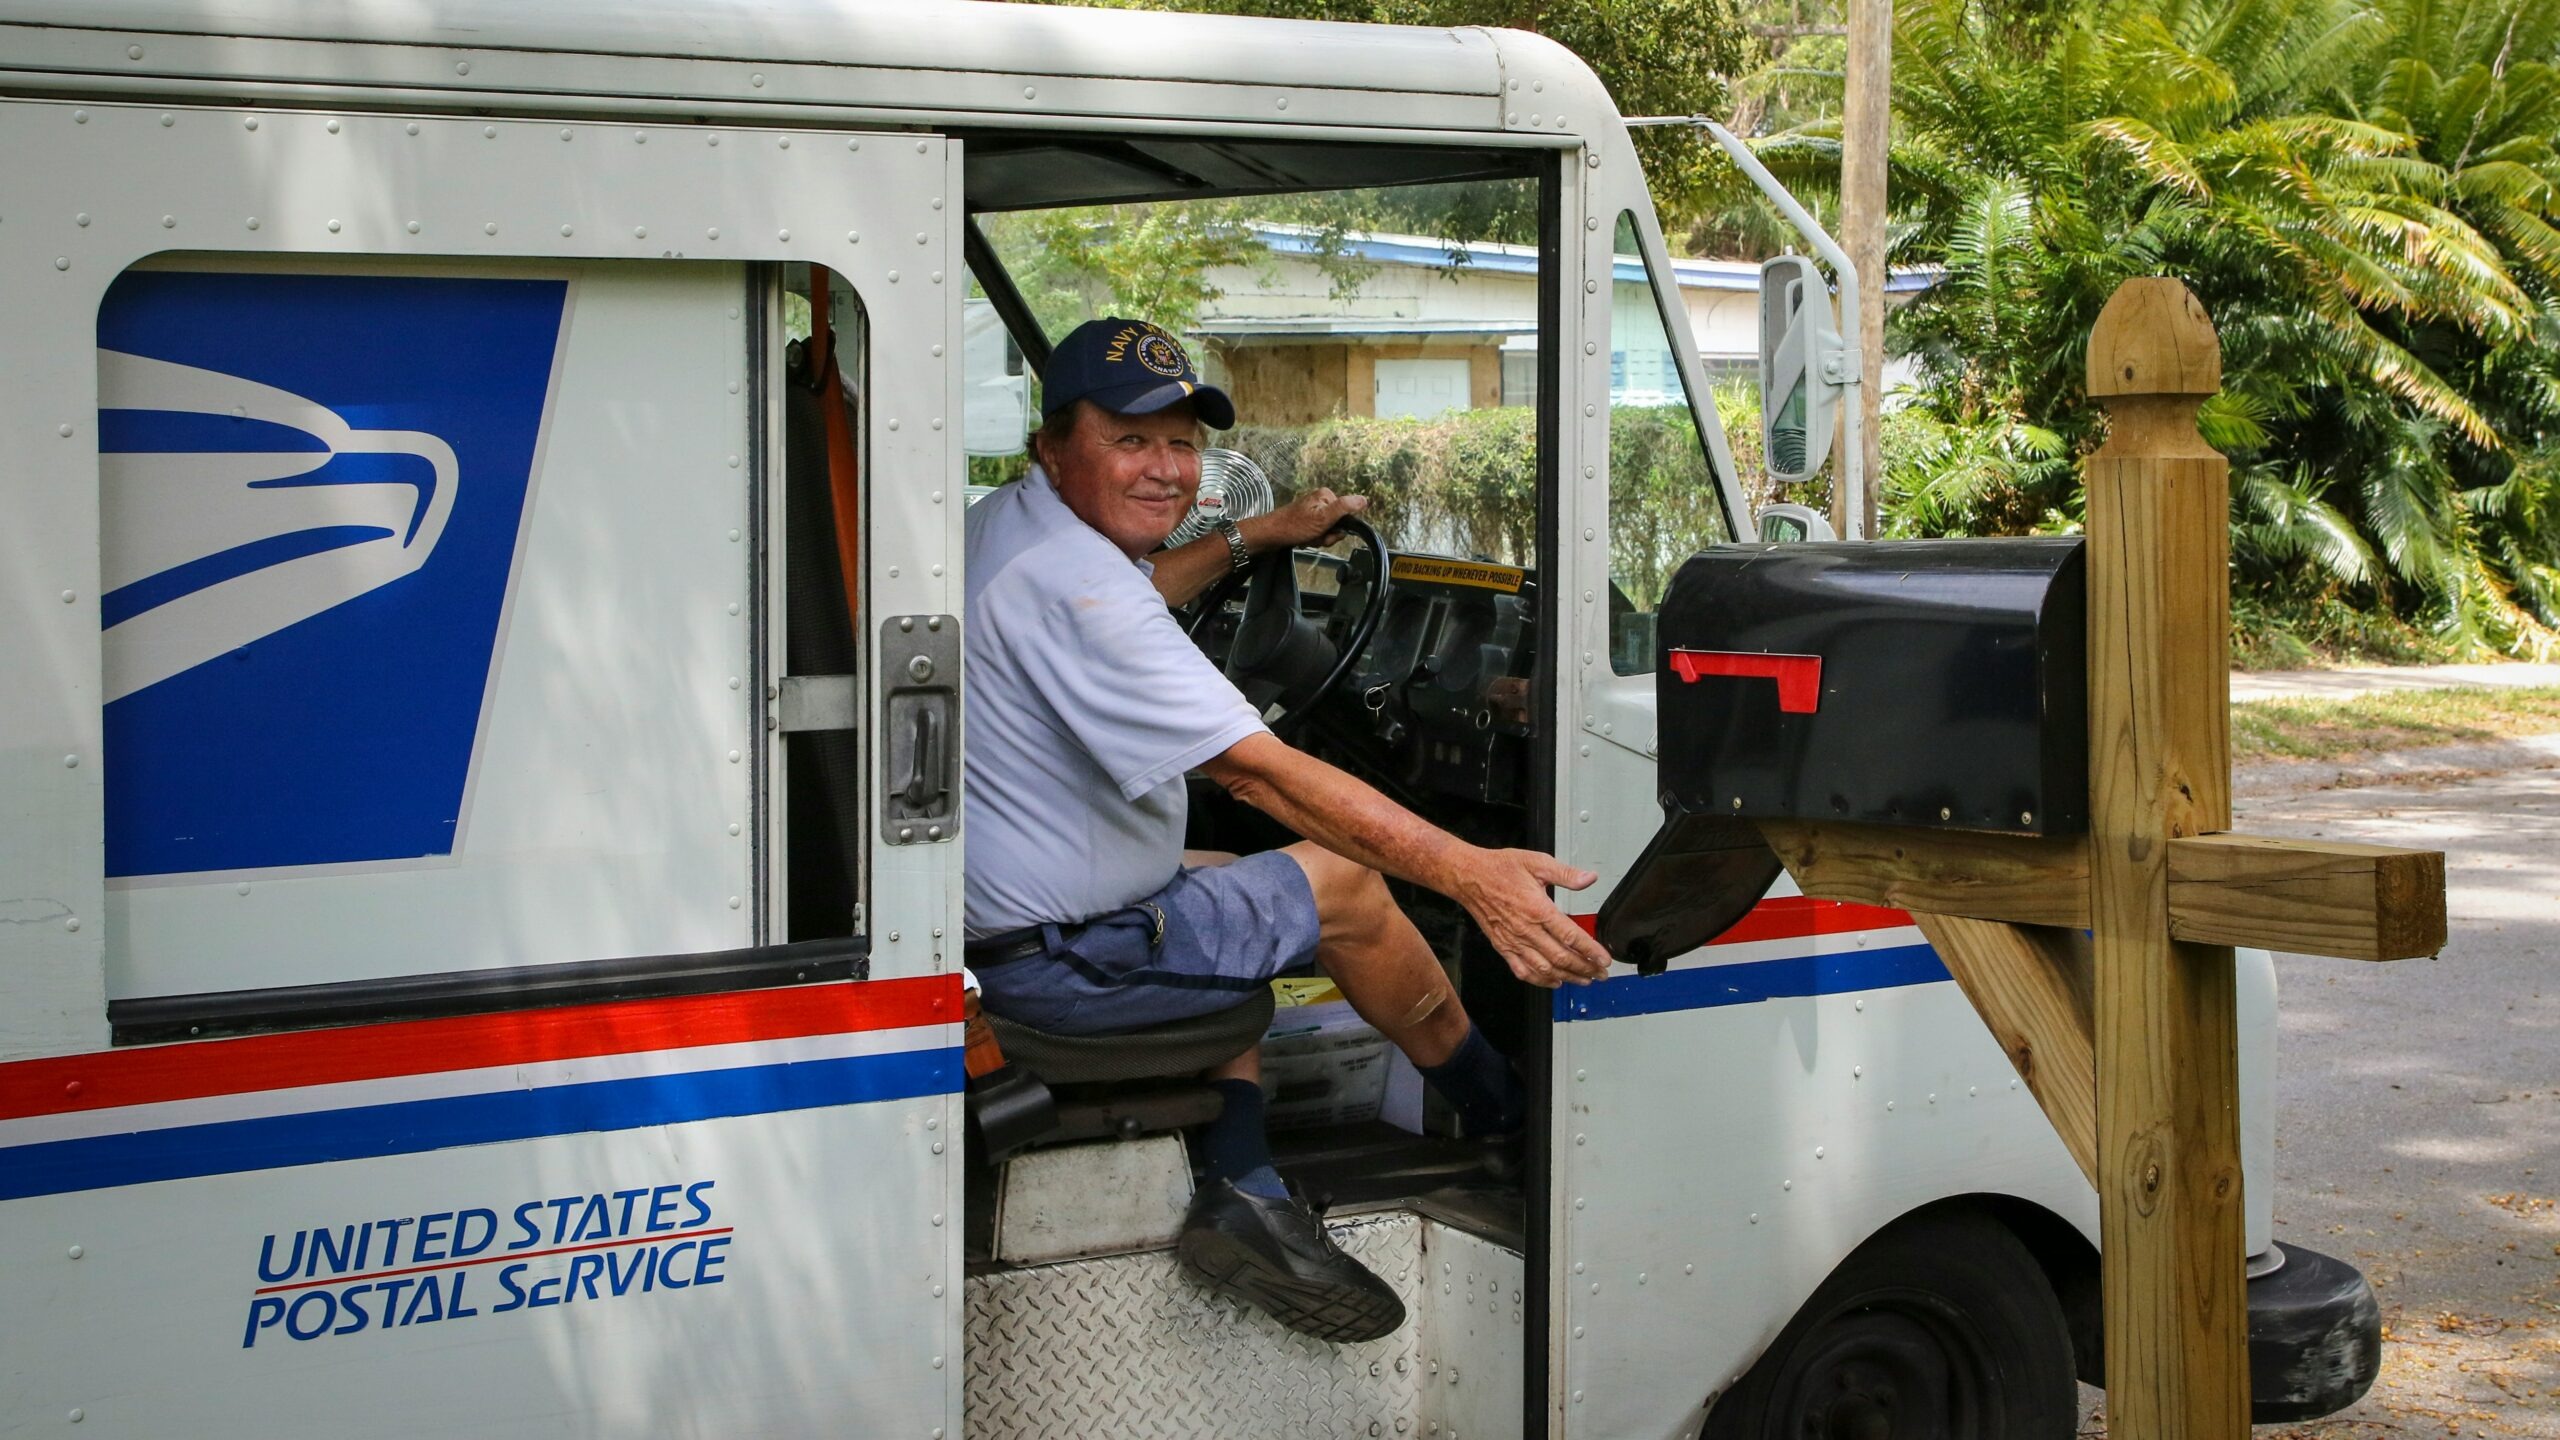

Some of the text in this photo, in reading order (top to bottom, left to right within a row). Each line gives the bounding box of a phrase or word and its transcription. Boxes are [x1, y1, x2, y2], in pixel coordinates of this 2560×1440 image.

[1106, 327, 1138, 361] NAVY
[1394, 561, 1520, 587] AVOID BACKING UP WHENEVER POSSIBLE
[257, 1180, 715, 1283] UNITED STATES
[243, 1271, 478, 1349] POSTAL
